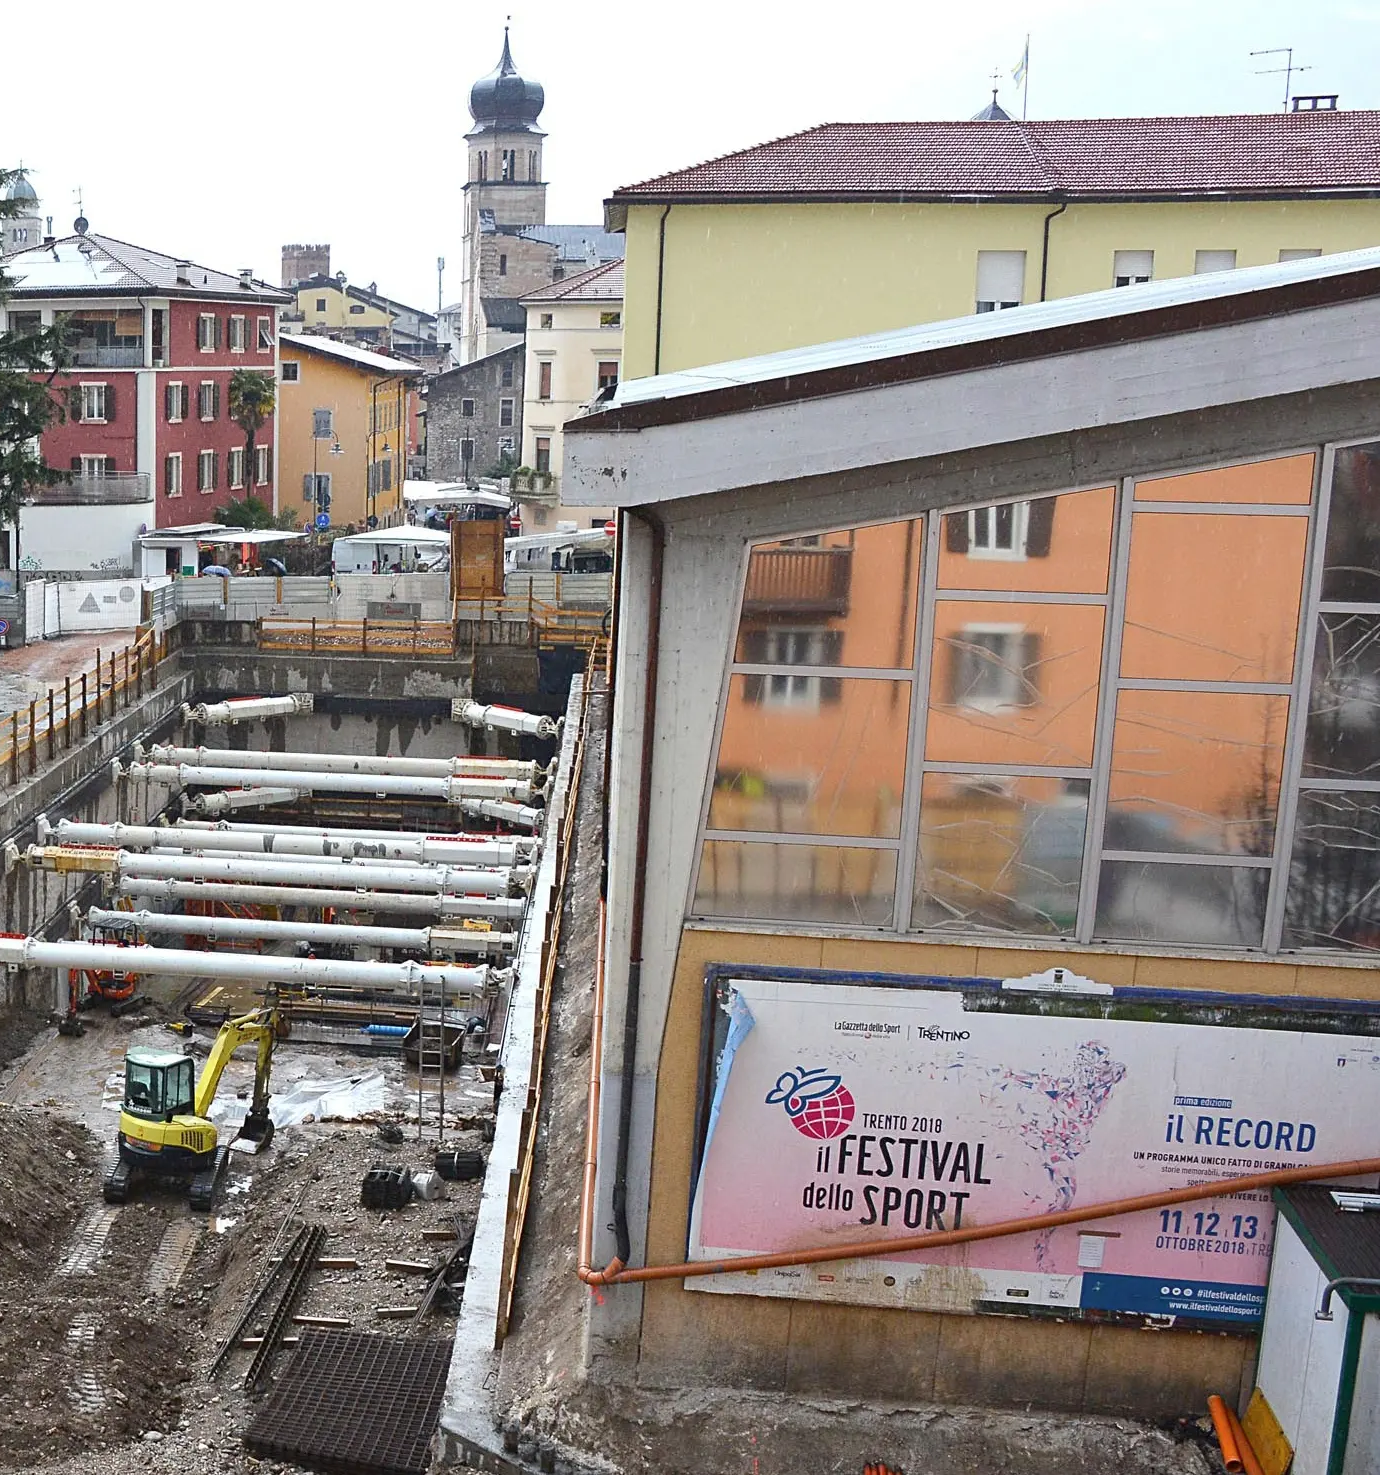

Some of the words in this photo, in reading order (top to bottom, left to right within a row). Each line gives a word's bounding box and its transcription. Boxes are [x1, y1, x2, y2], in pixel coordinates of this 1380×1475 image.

[834, 1021, 842, 1031] La
[842, 1021, 868, 1032] Gazzetta
[868, 1022, 884, 1033] dello
[884, 1023, 901, 1035] Sport
[917, 1026, 971, 1042] TRENTINO
[1174, 1096, 1198, 1107] prima
[1200, 1097, 1232, 1108] edizione
[862, 1113, 907, 1131] TRENTO
[912, 1117, 943, 1134] 2018
[1165, 1114, 1184, 1143] il
[1194, 1115, 1316, 1153] RECORD
[816, 1145, 831, 1174] il
[838, 1134, 991, 1185] FESTIVAL
[1133, 1151, 1145, 1161] UN
[1147, 1152, 1199, 1165] PROGRAMMA
[1201, 1156, 1226, 1167] UNICO
[1227, 1158, 1252, 1169] FATTO
[1253, 1160, 1263, 1170] DI
[1161, 1165, 1180, 1175] storie
[1181, 1166, 1220, 1178] memorabili,
[803, 1182, 854, 1211] dello
[859, 1184, 971, 1231] SPORT
[1229, 1192, 1257, 1202] VIVERE
[1160, 1209, 1182, 1234] 11
[1194, 1212, 1220, 1236] 12
[1232, 1215, 1258, 1239] 13
[1155, 1235, 1212, 1252] OTTOBRE
[1214, 1240, 1245, 1255] 2018
